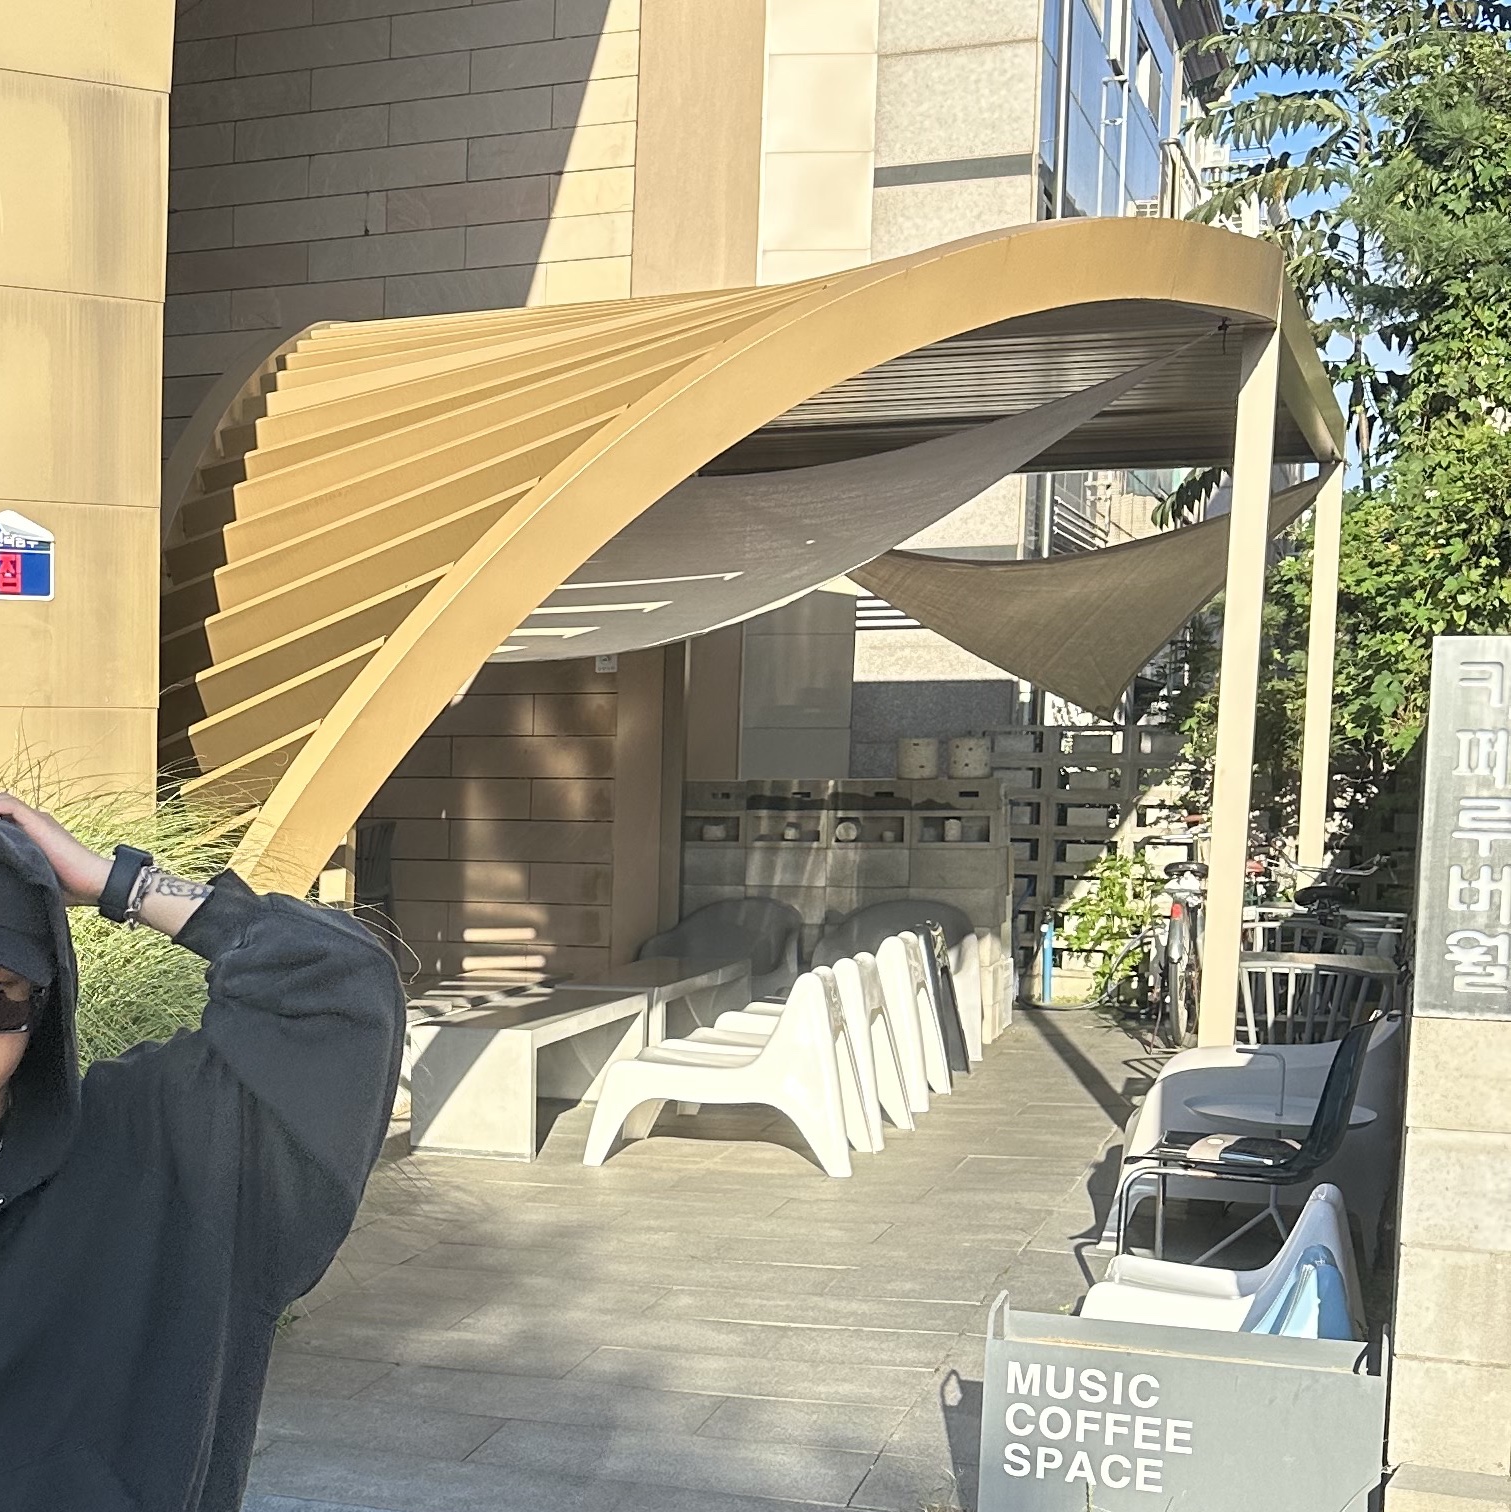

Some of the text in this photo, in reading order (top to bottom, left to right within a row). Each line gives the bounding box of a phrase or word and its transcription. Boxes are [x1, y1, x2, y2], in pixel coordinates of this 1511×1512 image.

[1006, 1360, 1160, 1409] MUSIC
[1005, 1402, 1194, 1455] COFFEE
[1003, 1442, 1164, 1493] SPACE
